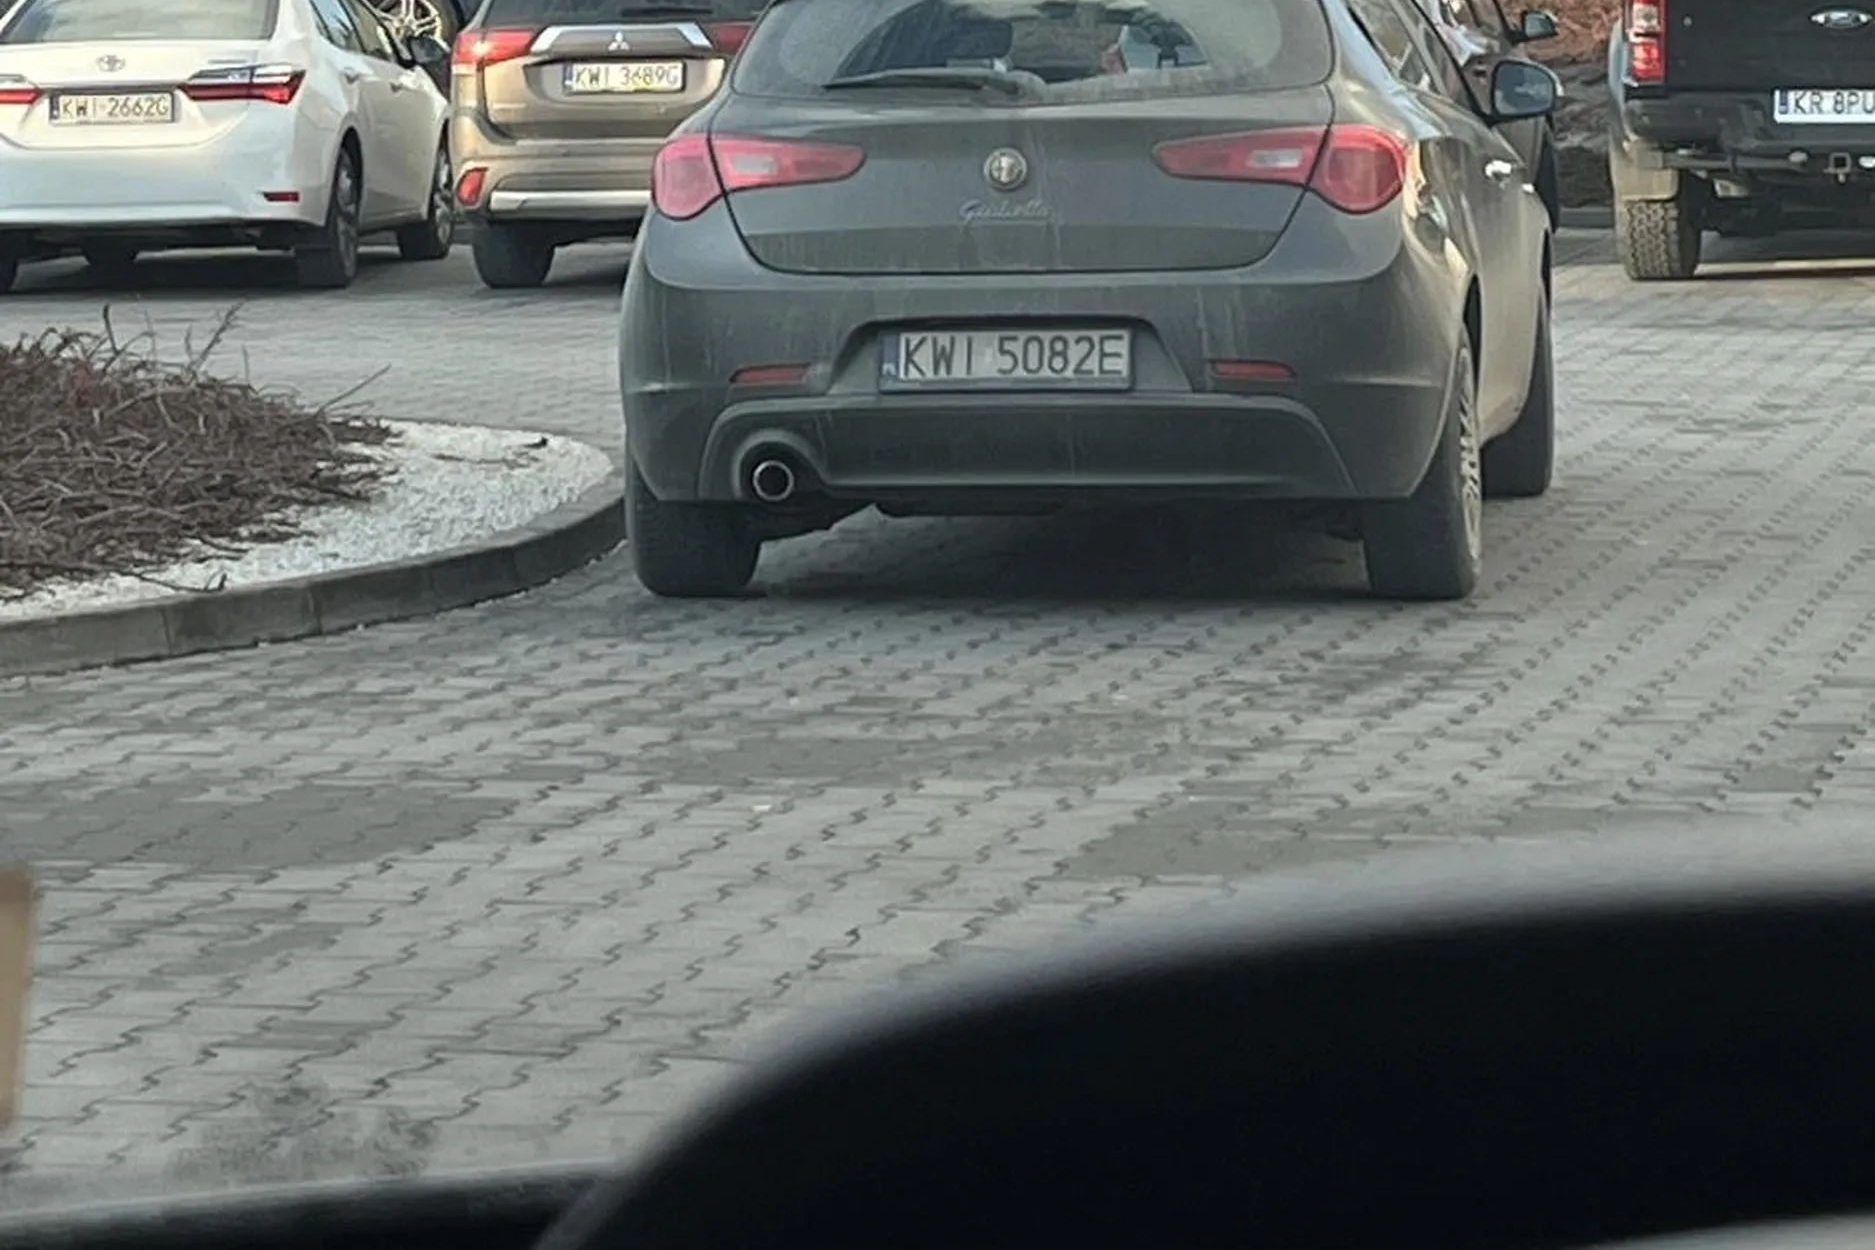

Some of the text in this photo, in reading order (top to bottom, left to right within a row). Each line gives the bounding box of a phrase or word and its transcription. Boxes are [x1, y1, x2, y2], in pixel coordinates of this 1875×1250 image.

[575, 66, 610, 87] KWI
[63, 97, 97, 119] KWI
[1793, 91, 1823, 114] KR
[903, 334, 1125, 377] KWI 5082E
